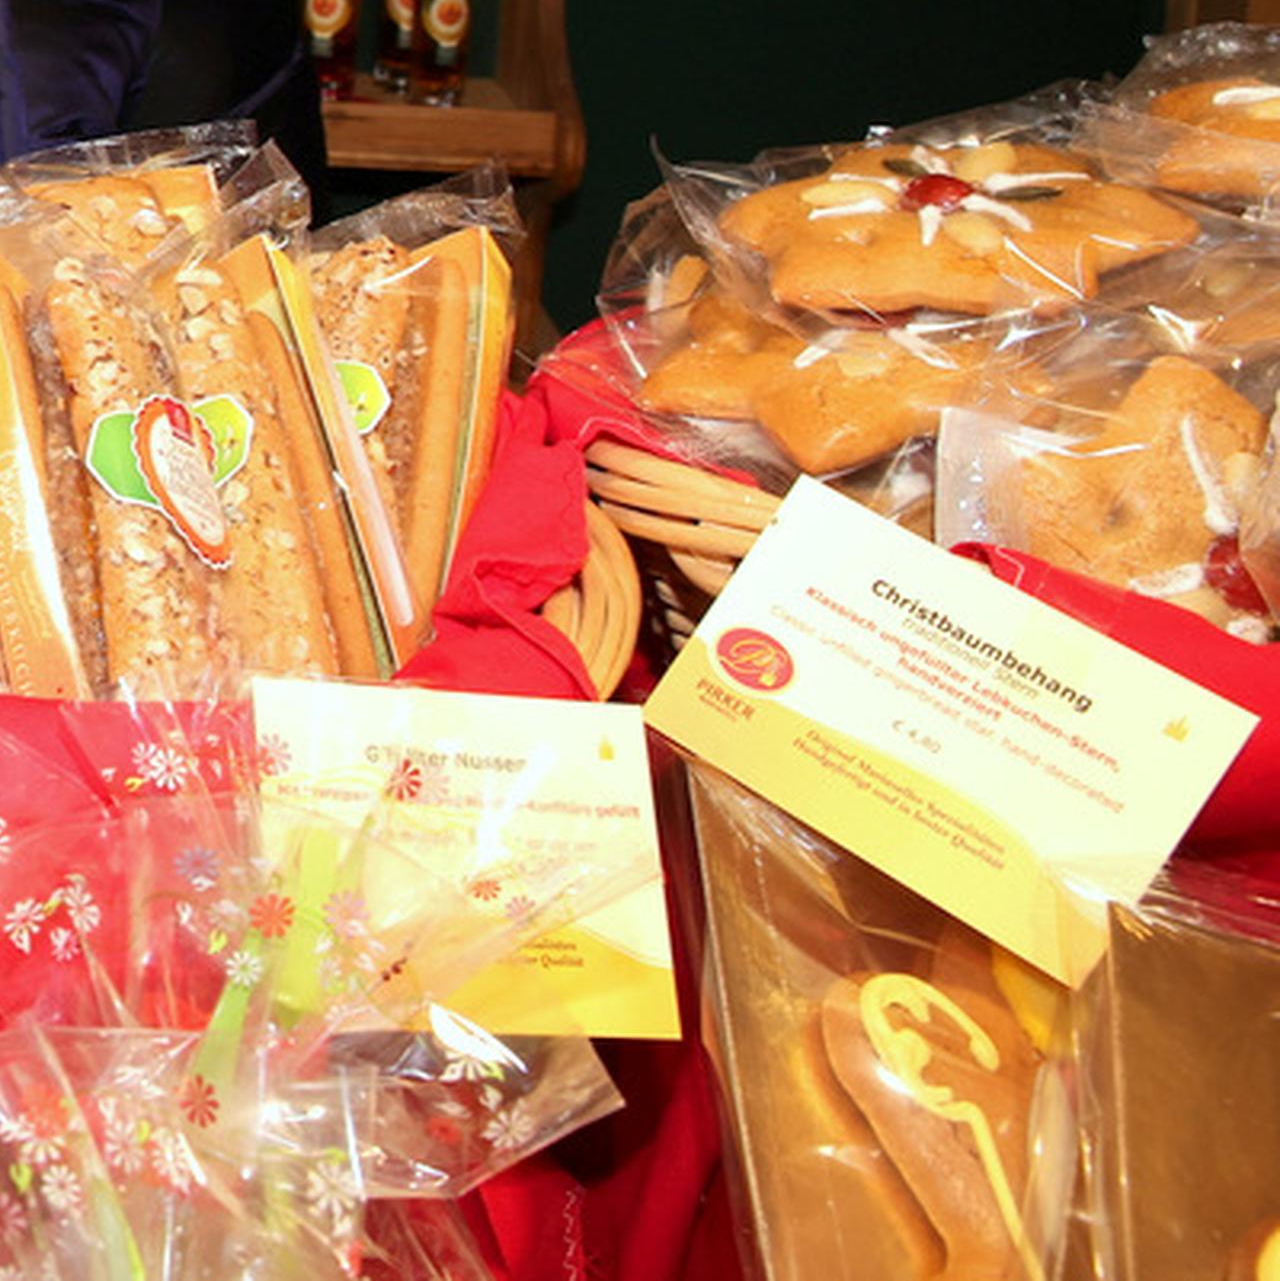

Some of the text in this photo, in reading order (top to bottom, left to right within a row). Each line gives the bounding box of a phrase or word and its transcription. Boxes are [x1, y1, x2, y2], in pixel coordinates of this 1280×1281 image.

[804, 587, 879, 634] Klassisch
[969, 680, 1125, 773] Lebkuchen-Stern,
[867, 578, 1095, 714] Christbaumbehang
[694, 679, 757, 721] PIRKER
[895, 657, 1002, 722] handverziert
[991, 666, 1041, 701] Stern
[998, 736, 1126, 814] hand-decorated
